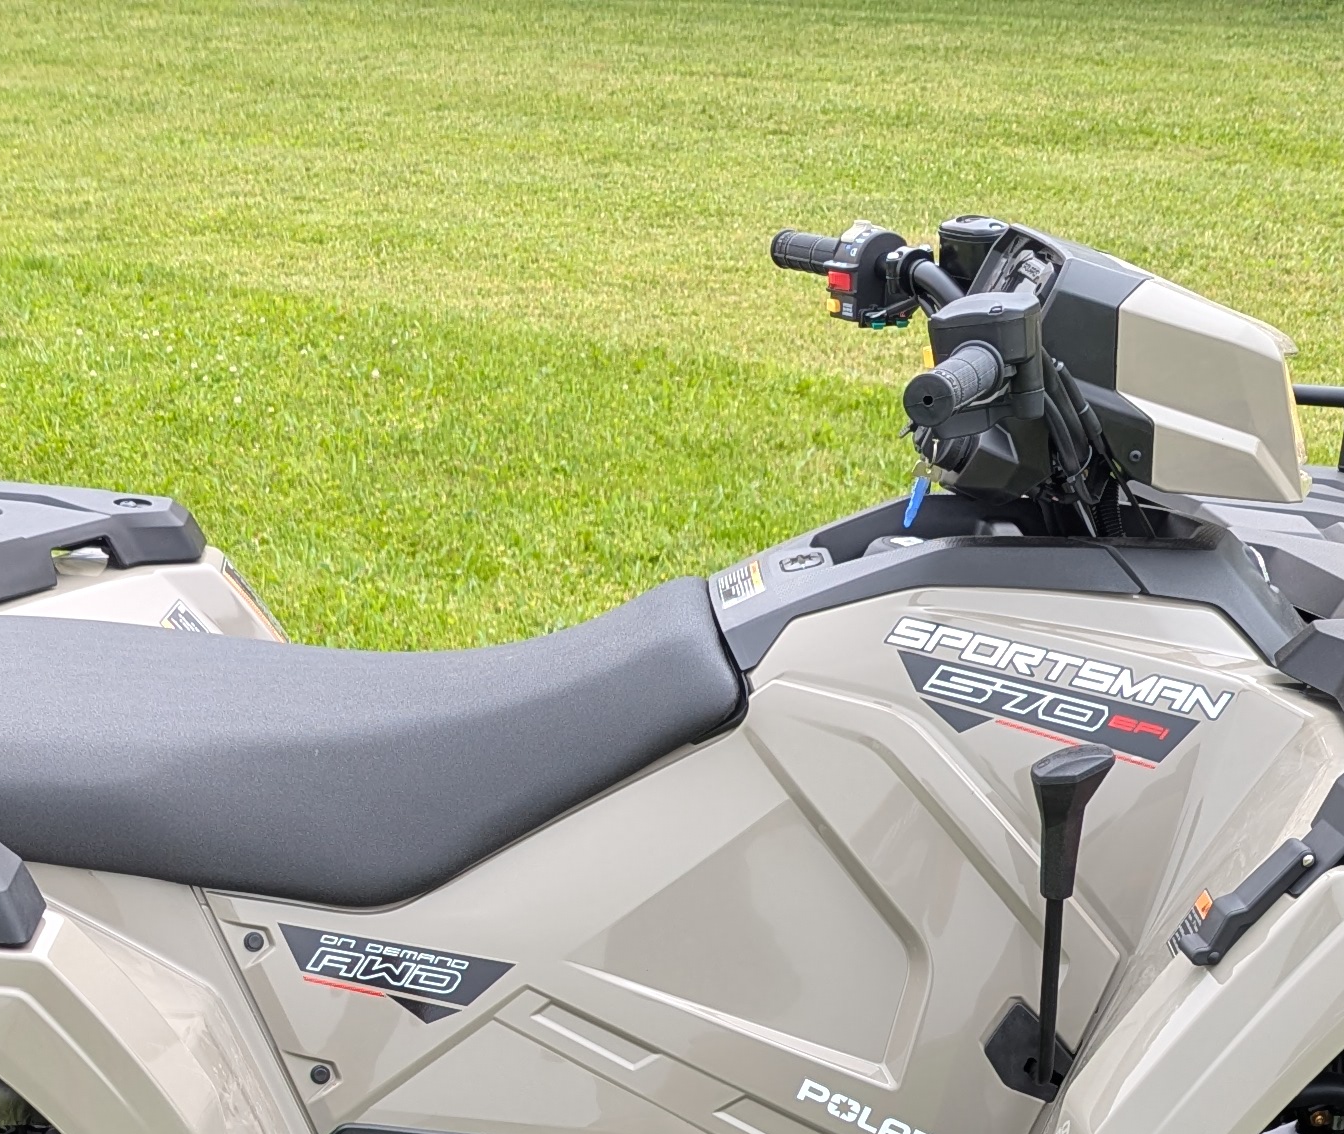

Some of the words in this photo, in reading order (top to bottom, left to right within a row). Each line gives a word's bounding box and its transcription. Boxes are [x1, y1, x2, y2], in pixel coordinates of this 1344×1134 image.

[885, 617, 1235, 720] SPORTSMAN
[924, 666, 1109, 732] 570
[1108, 714, 1170, 740] EFI
[306, 946, 462, 994] AWD
[320, 934, 356, 948] ON
[365, 942, 469, 969] DEMAND
